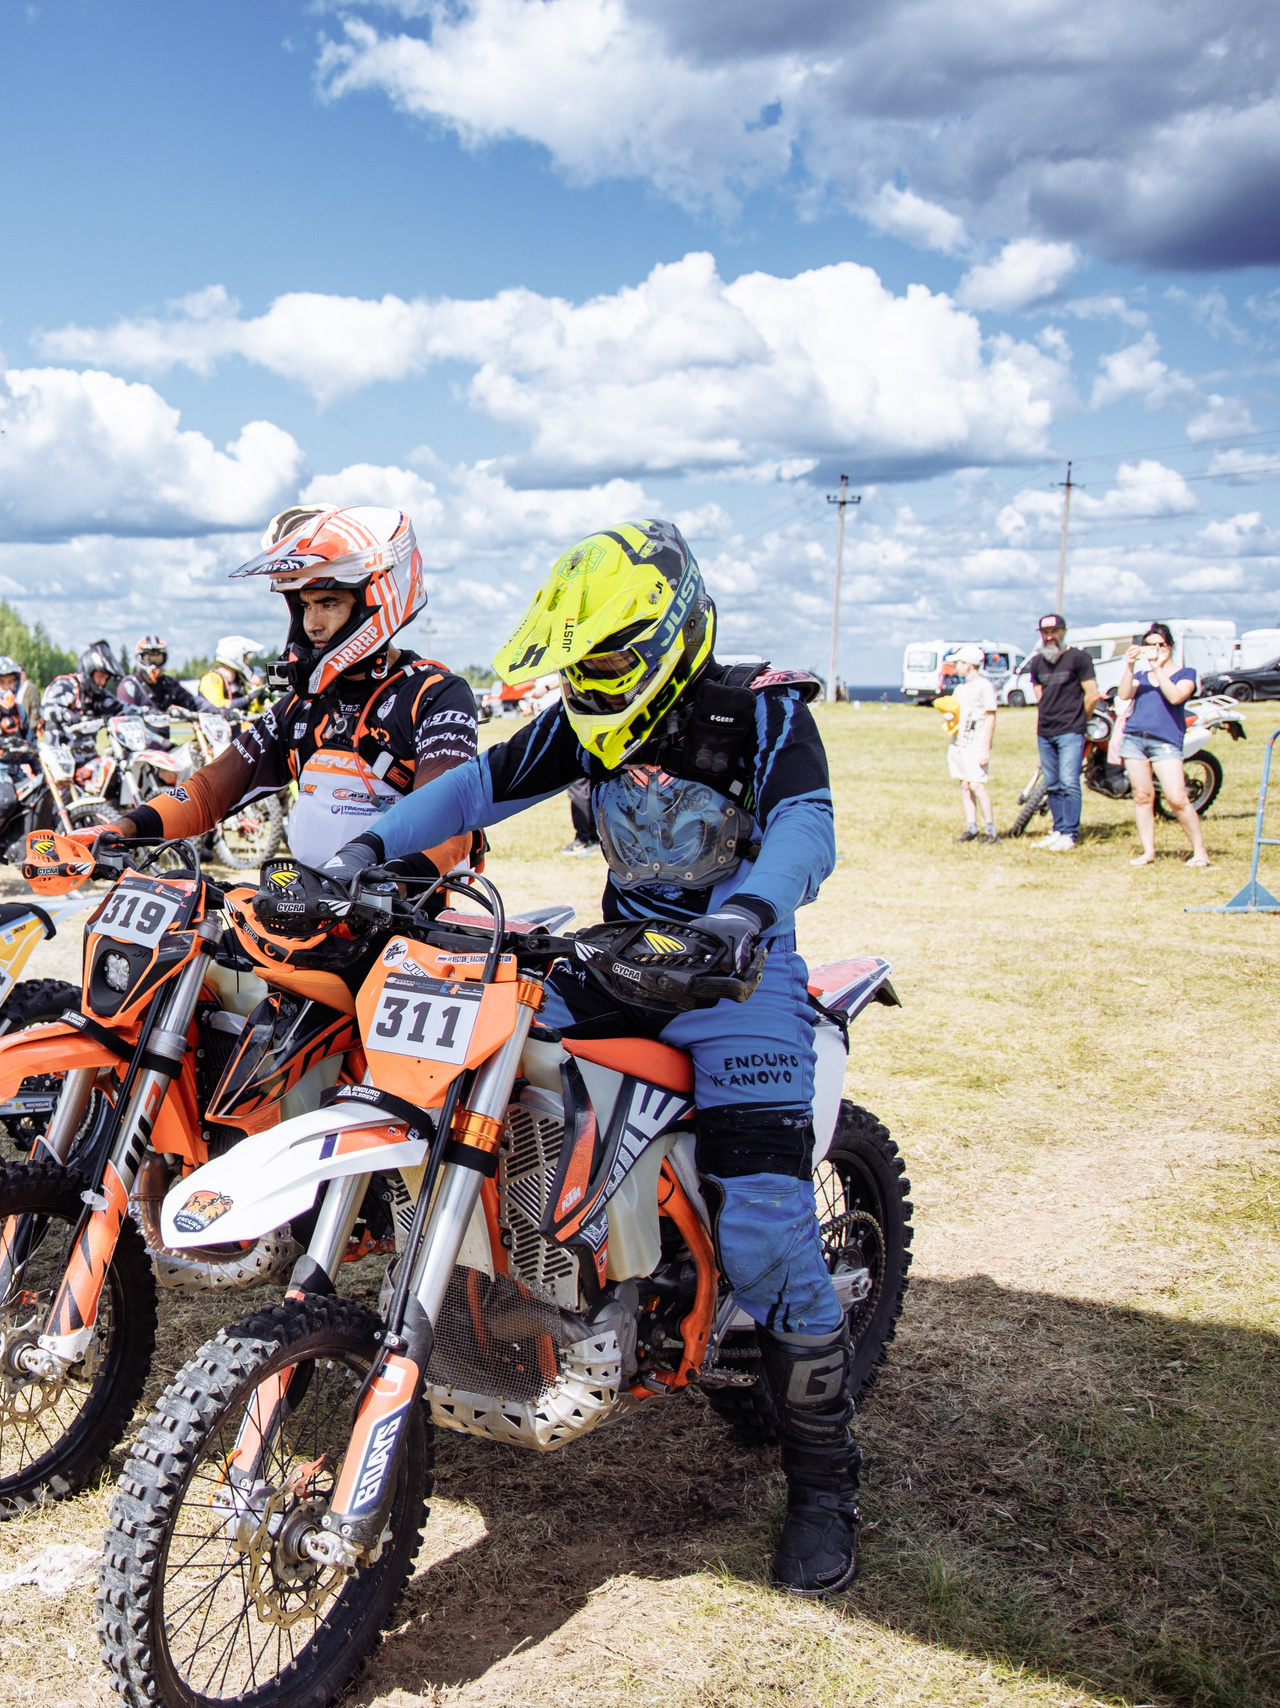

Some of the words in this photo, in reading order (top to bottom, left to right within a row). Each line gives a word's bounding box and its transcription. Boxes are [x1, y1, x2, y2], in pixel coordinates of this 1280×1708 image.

[561, 617, 575, 652] JUST1
[101, 894, 167, 936] 319
[276, 902, 306, 913] CYCRA
[242, 922, 260, 944] CYCRA
[611, 961, 642, 983] CYCRA
[375, 995, 462, 1049] 311
[723, 1053, 799, 1072] ENDURO
[351, 1085, 381, 1098] ENDURO
[561, 1186, 582, 1213] KTM
